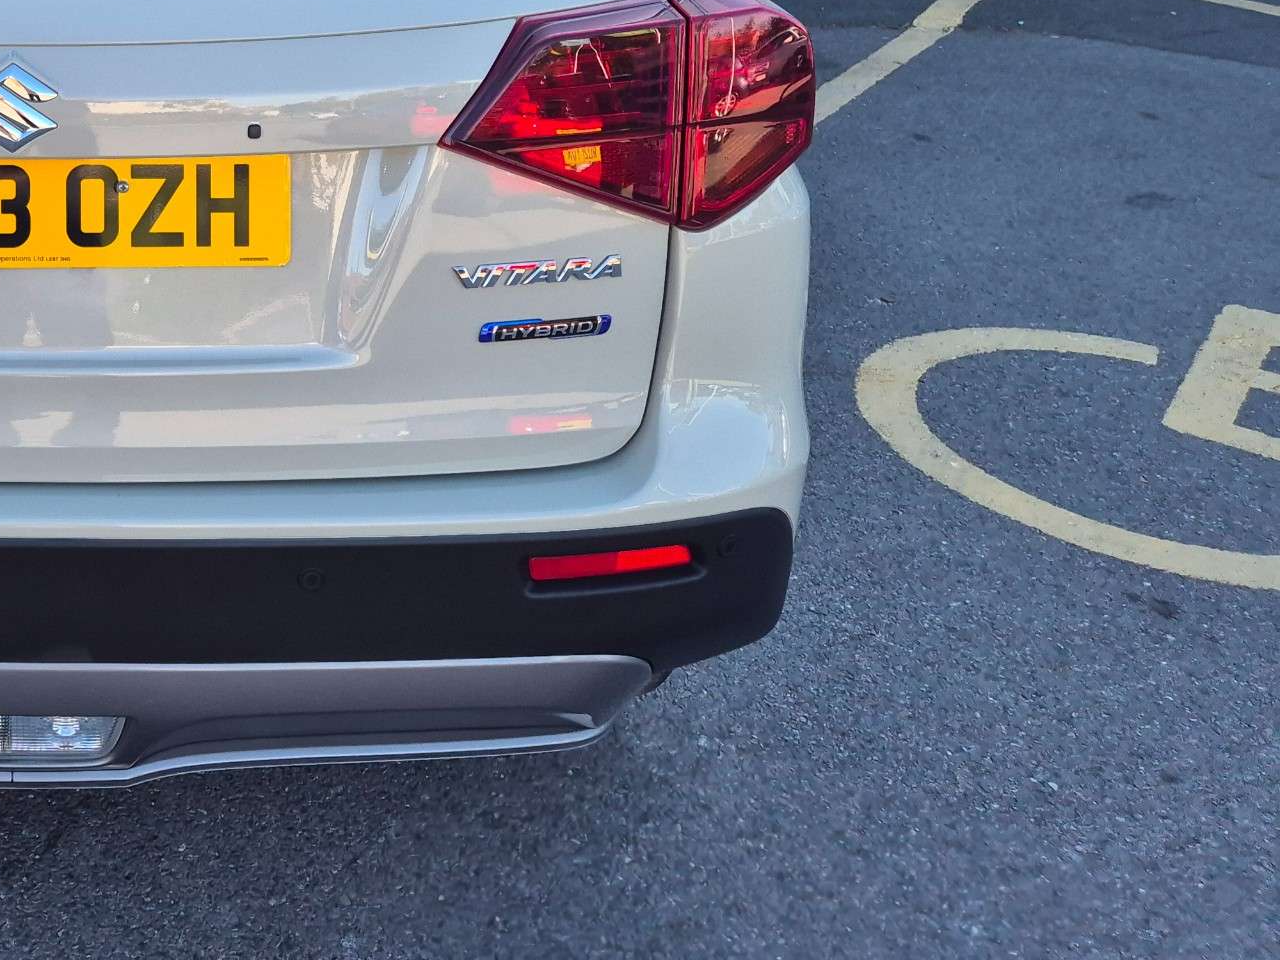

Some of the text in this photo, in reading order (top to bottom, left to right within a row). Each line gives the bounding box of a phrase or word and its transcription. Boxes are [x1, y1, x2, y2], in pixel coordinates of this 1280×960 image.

[65, 163, 250, 249] OZH
[451, 253, 623, 289] VITARA
[501, 320, 594, 340] HYBRID
